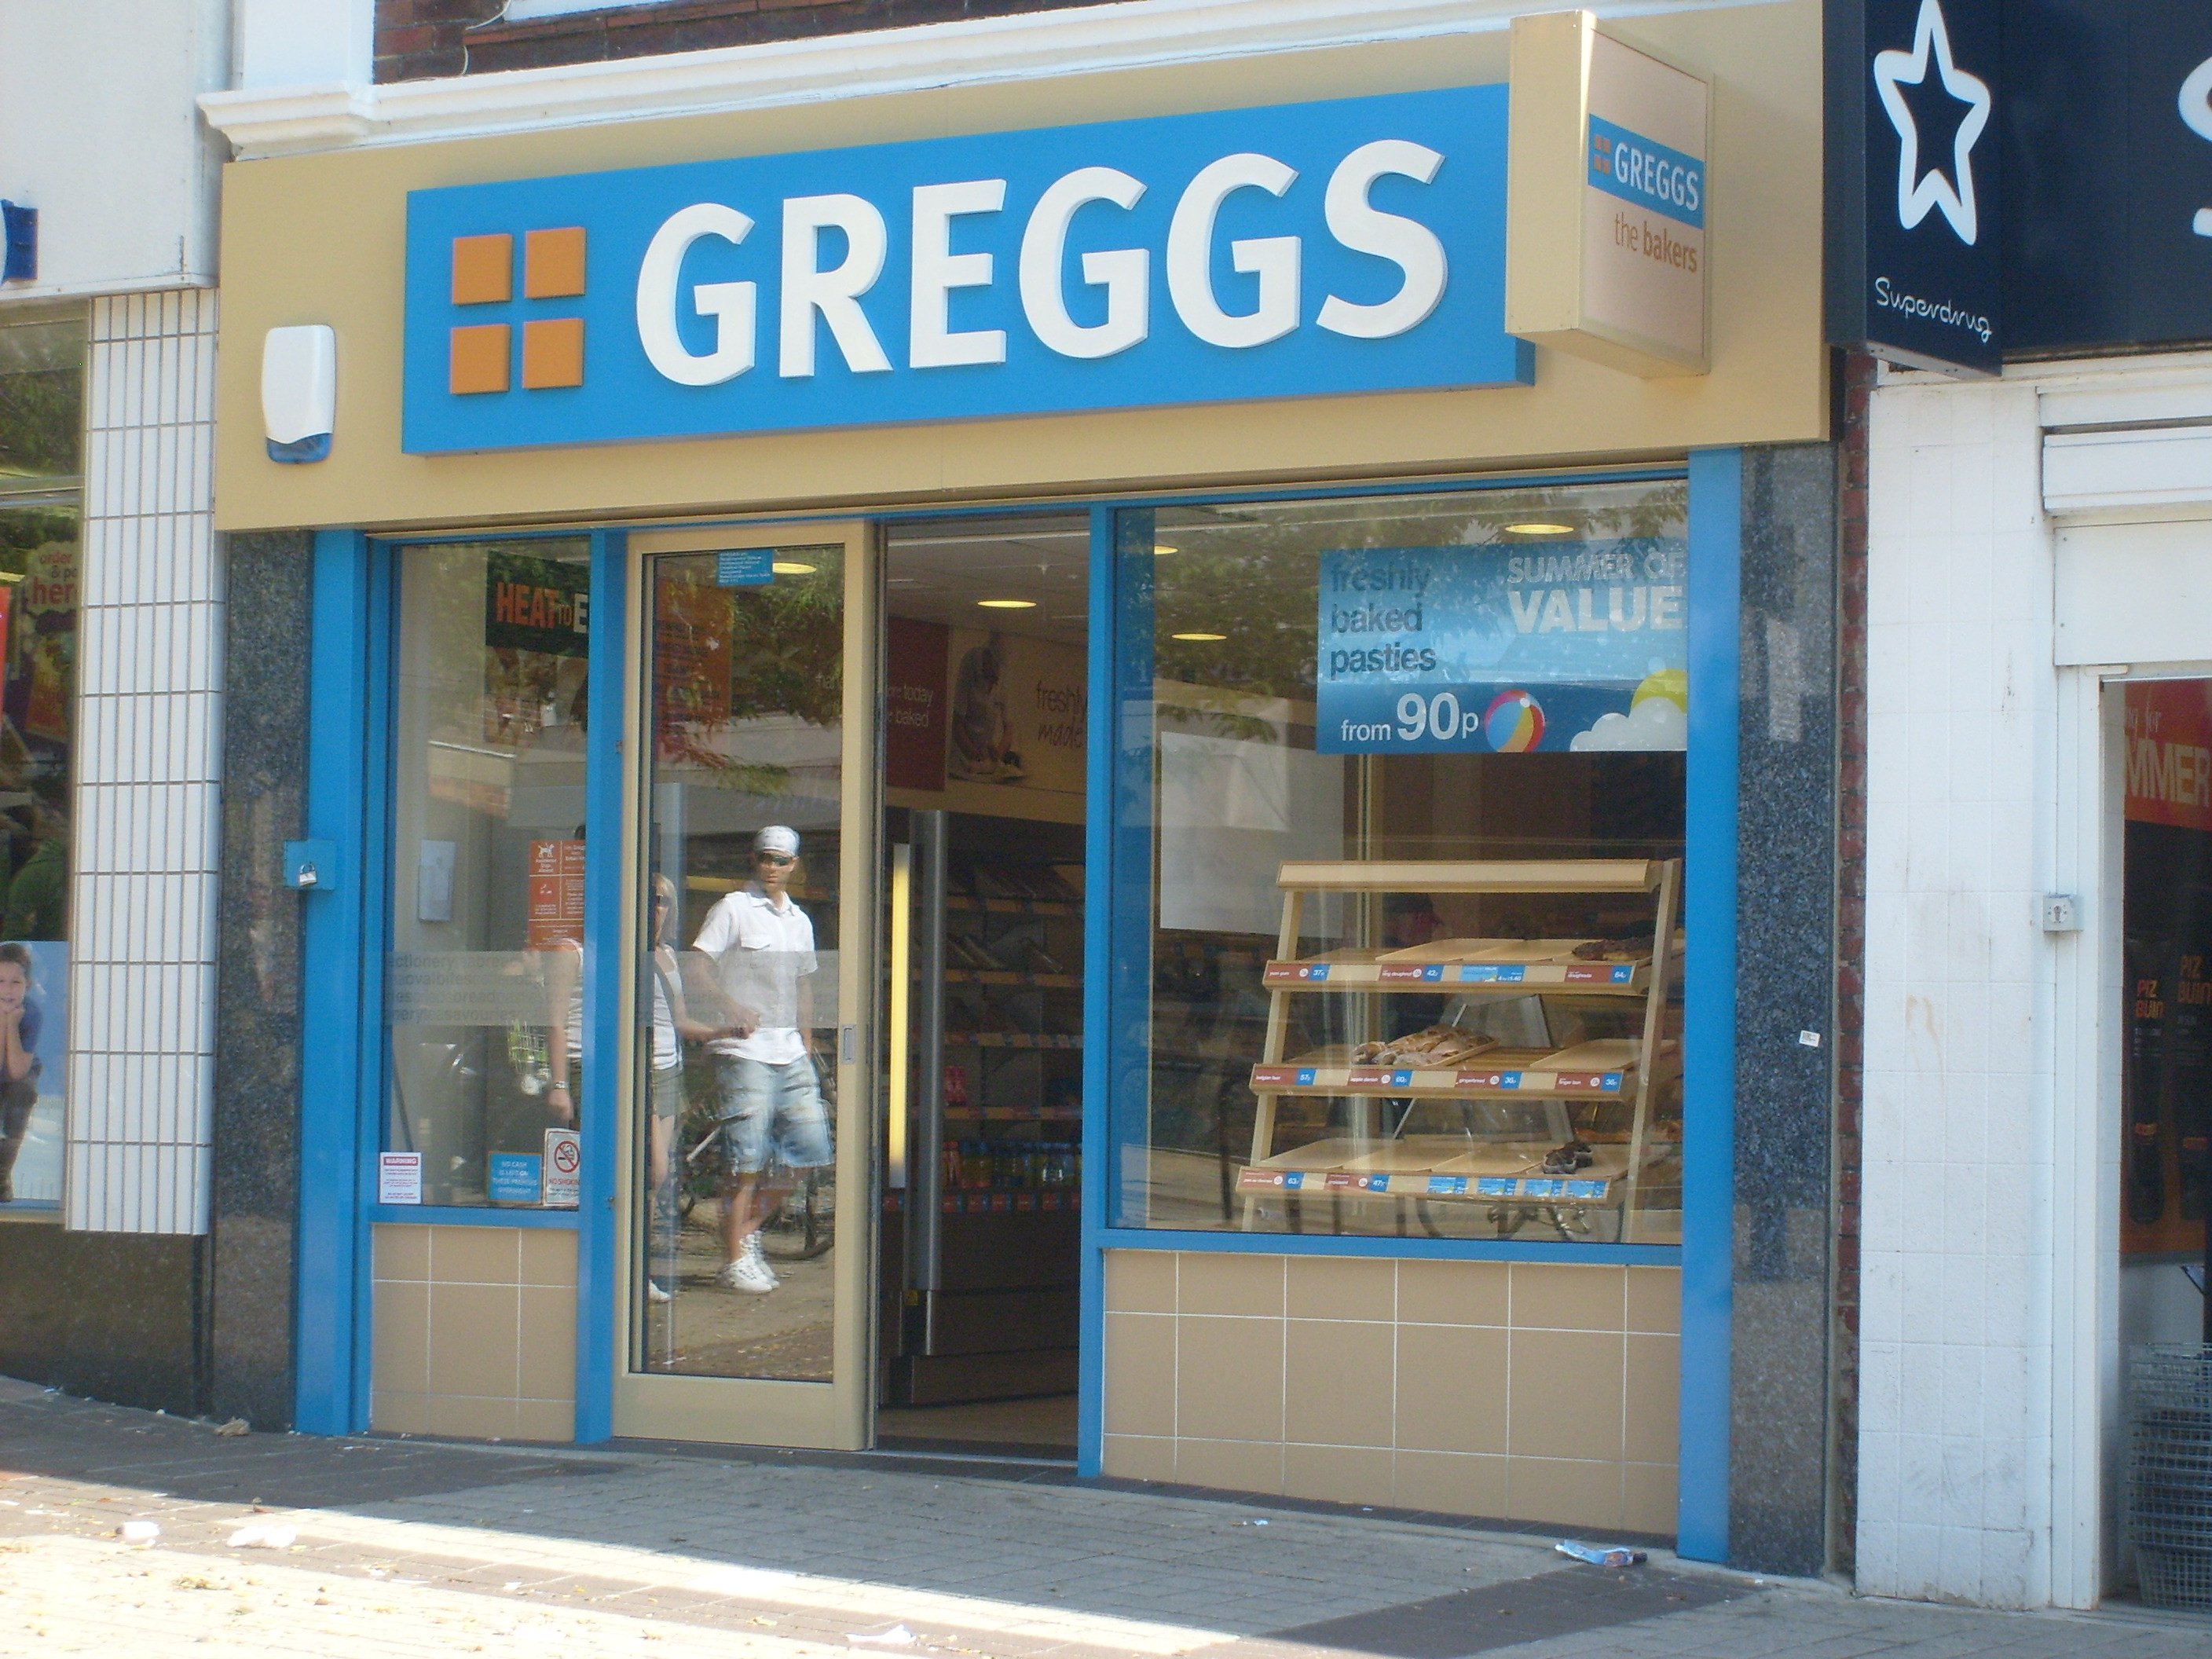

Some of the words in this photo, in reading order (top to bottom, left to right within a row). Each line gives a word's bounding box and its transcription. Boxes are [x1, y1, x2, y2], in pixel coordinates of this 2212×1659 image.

[1615, 142, 1698, 211] GREGGS
[635, 139, 1448, 386] GREGGS
[1615, 211, 1638, 252] the
[1643, 220, 1697, 273] bakers
[1874, 276, 1992, 343] Superdrug
[1330, 558, 1432, 598] freshly
[1507, 552, 1635, 584] SUMMER
[1643, 551, 1686, 580] OF
[496, 581, 560, 629] HEAT
[1331, 603, 1423, 633] baked
[1507, 584, 1685, 634] VALUE
[1330, 641, 1437, 681] pasties
[1340, 719, 1392, 742] from
[1397, 692, 1479, 741] 90p
